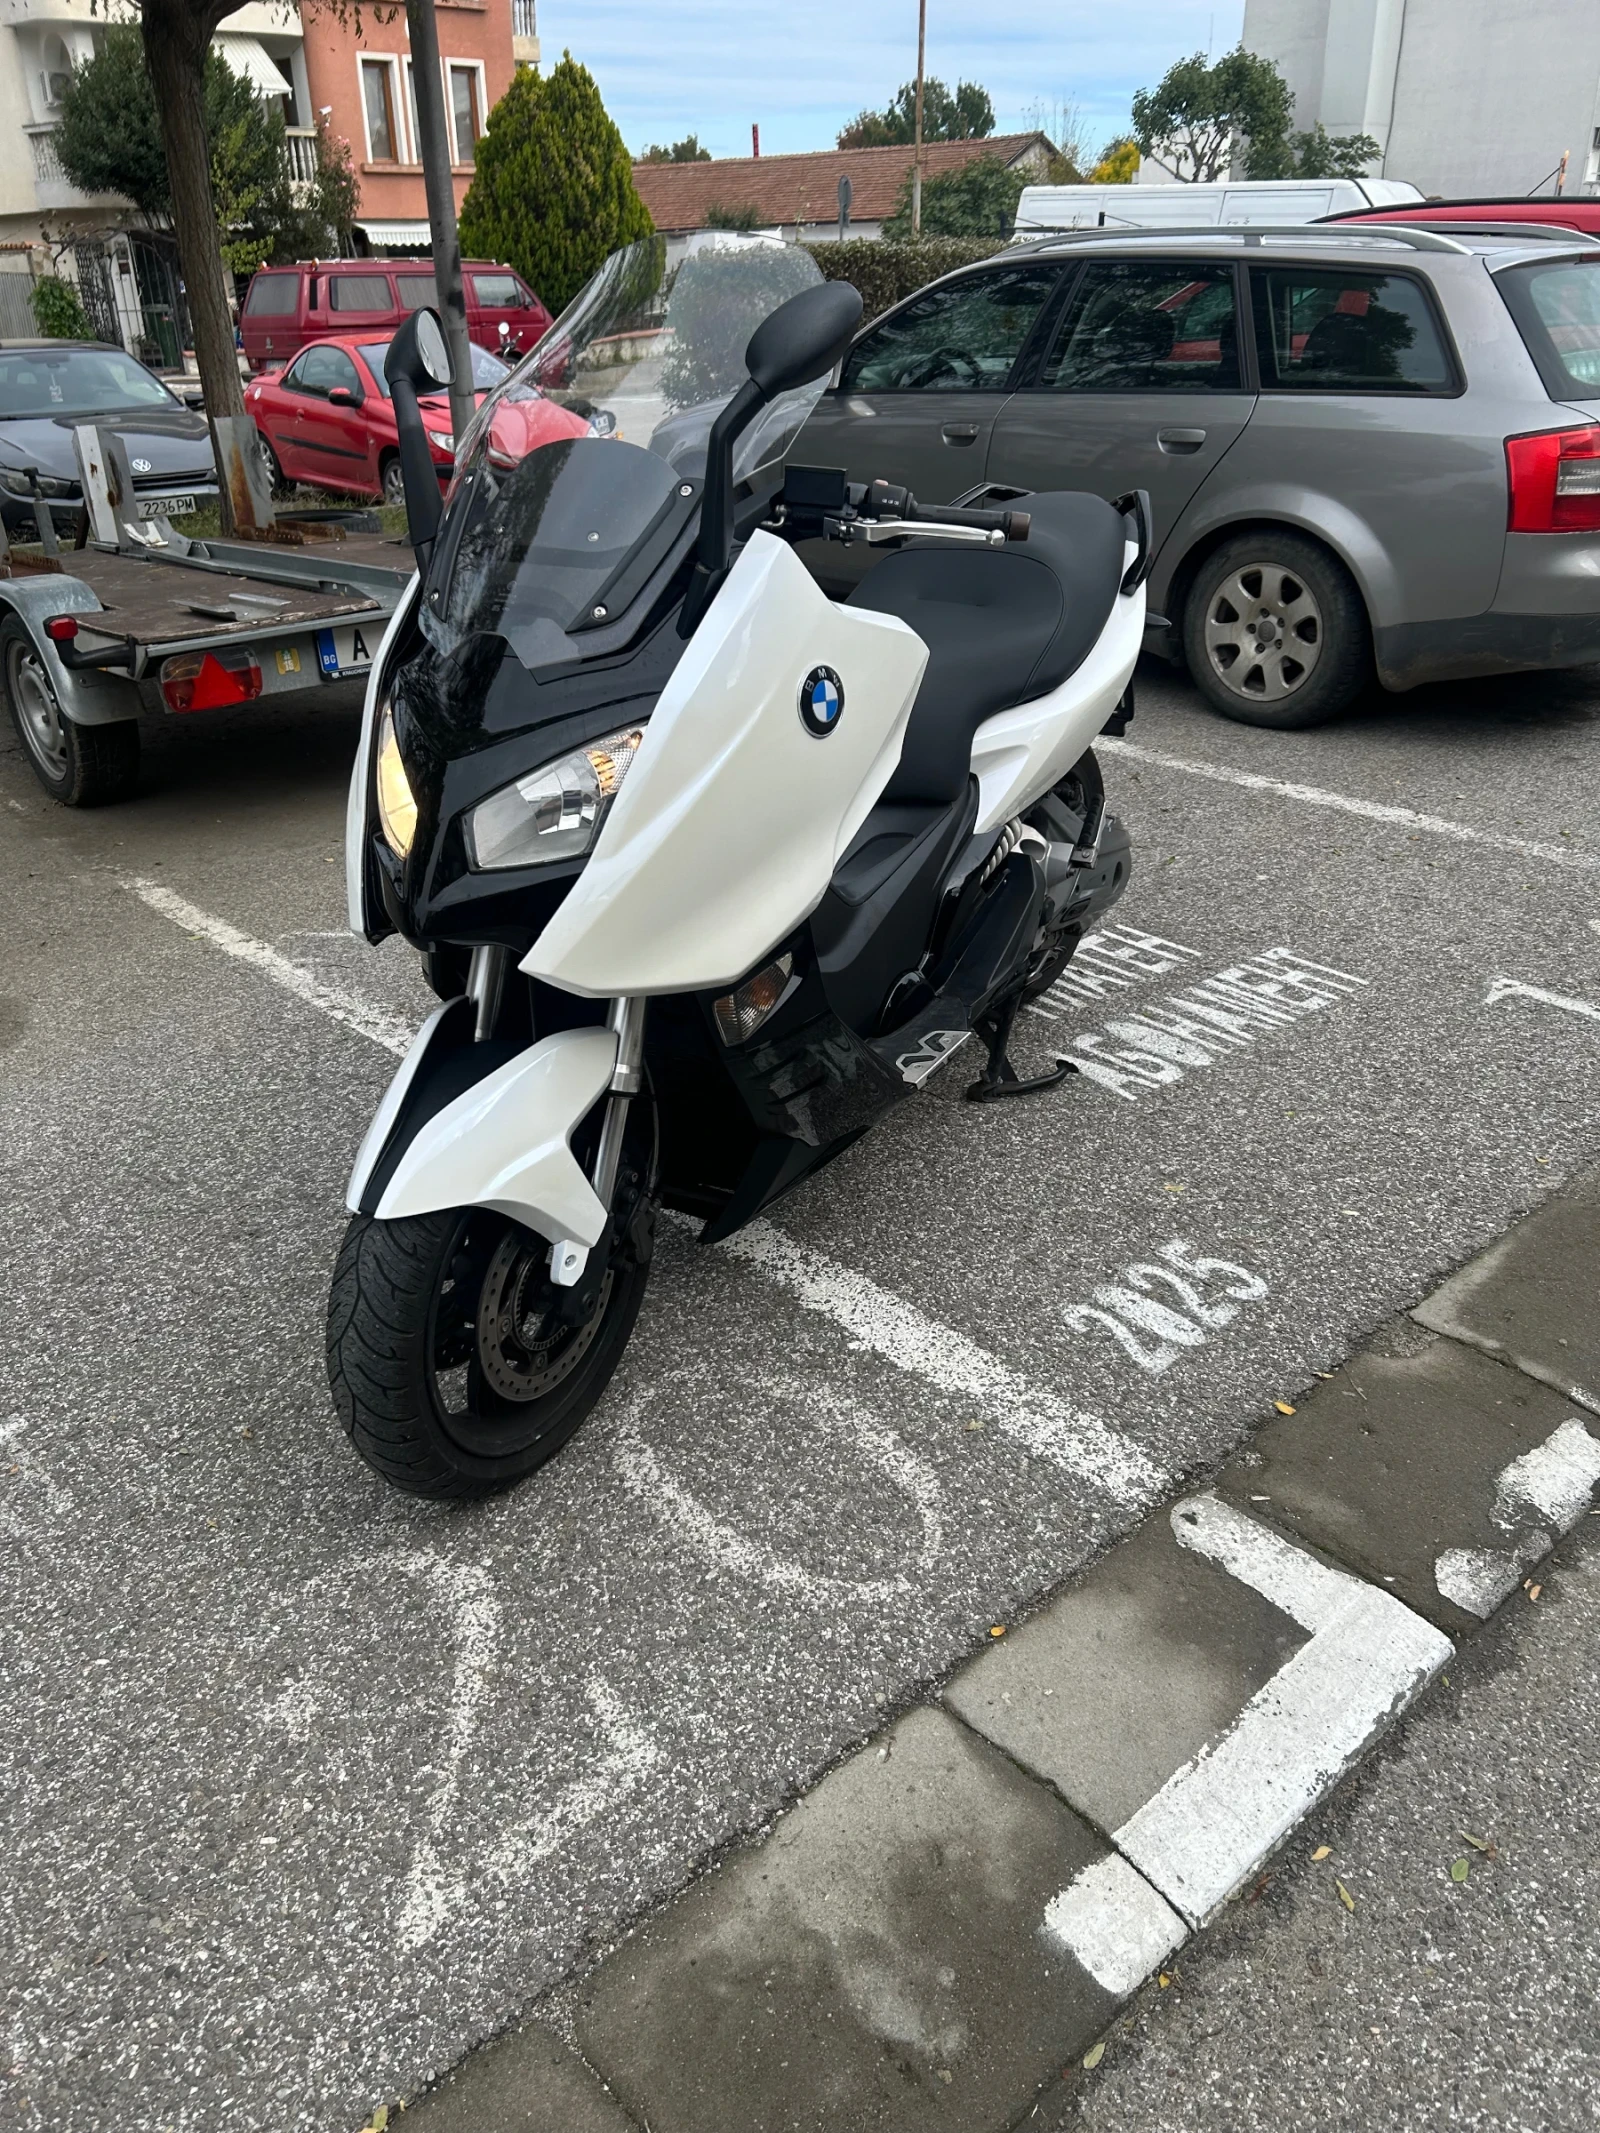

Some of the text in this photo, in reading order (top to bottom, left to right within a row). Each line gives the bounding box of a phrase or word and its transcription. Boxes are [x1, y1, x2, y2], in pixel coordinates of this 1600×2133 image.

[177, 498, 194, 512] PM
[323, 629, 371, 665] BG A
[804, 667, 840, 693] BMW
[1061, 1238, 1269, 1375] 2025
